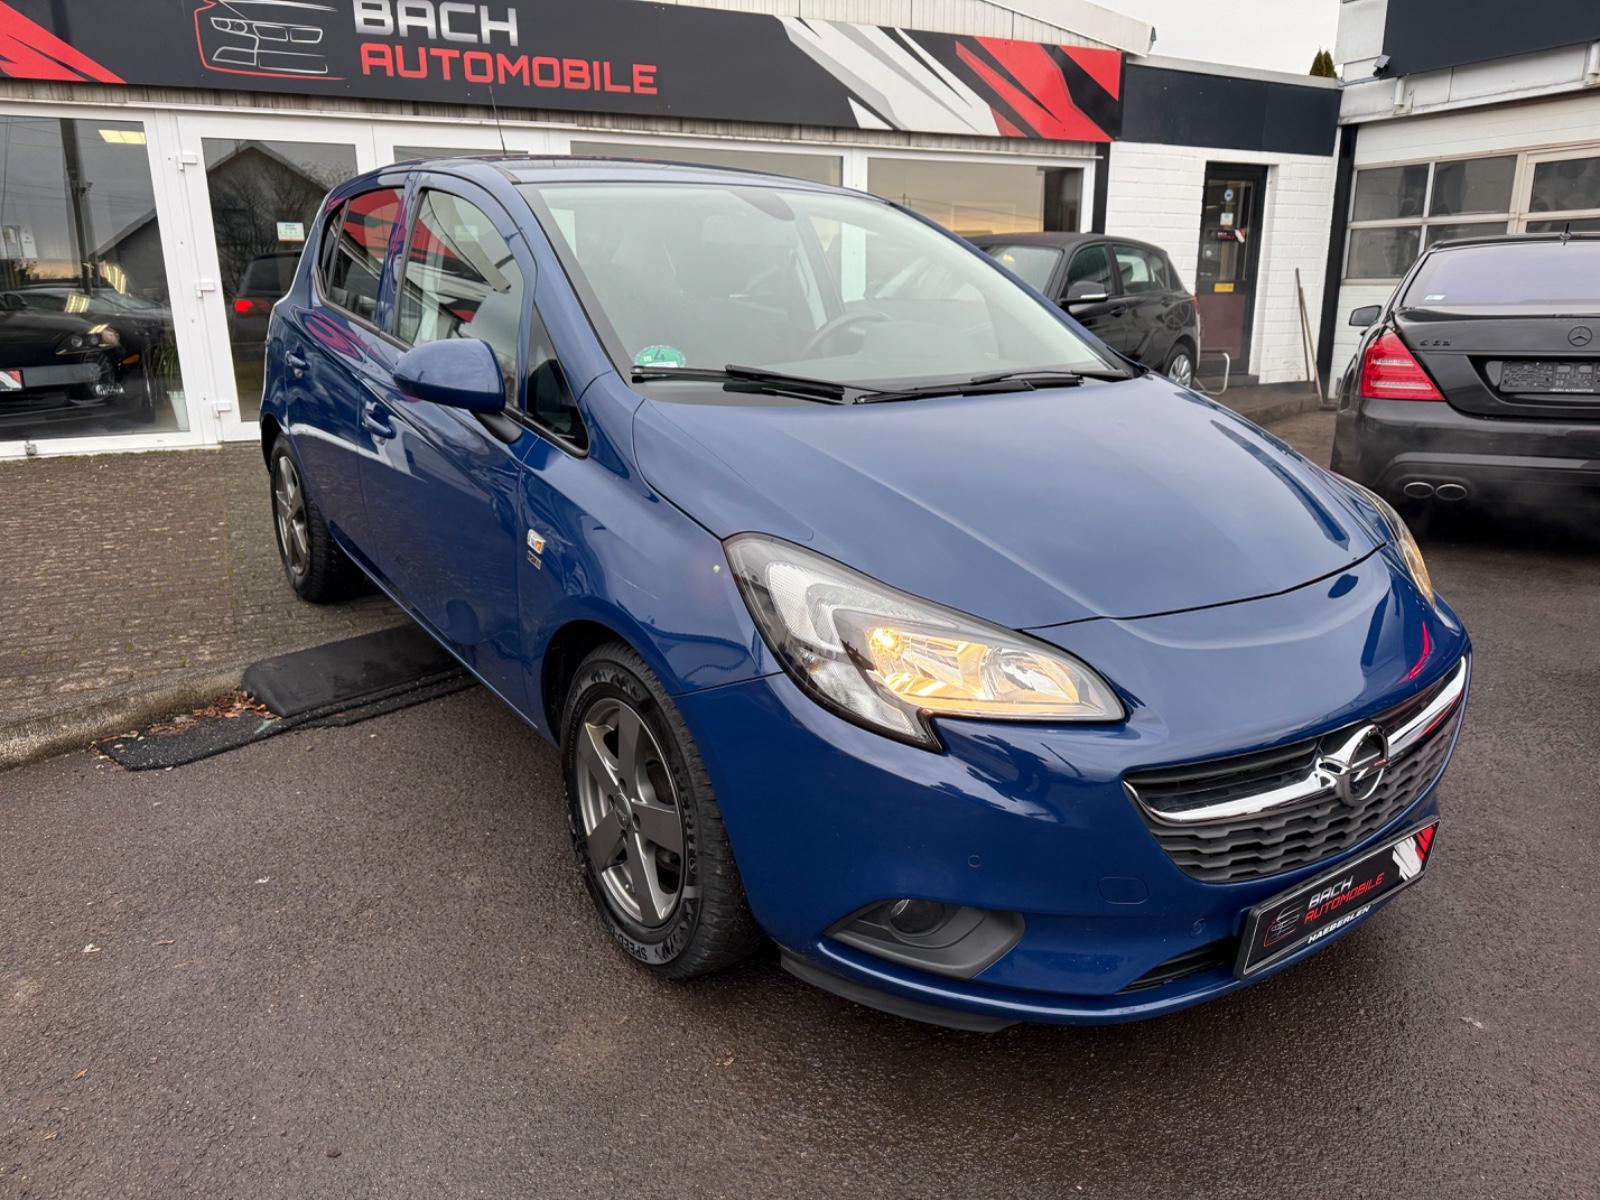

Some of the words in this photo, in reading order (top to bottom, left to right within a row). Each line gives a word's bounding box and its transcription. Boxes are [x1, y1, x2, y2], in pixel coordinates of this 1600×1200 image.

[353, 0, 518, 46] BACH
[360, 42, 658, 95] AUTOMOBILE
[1304, 872, 1385, 924] AUTOMOBILE
[1308, 875, 1354, 909] BACH
